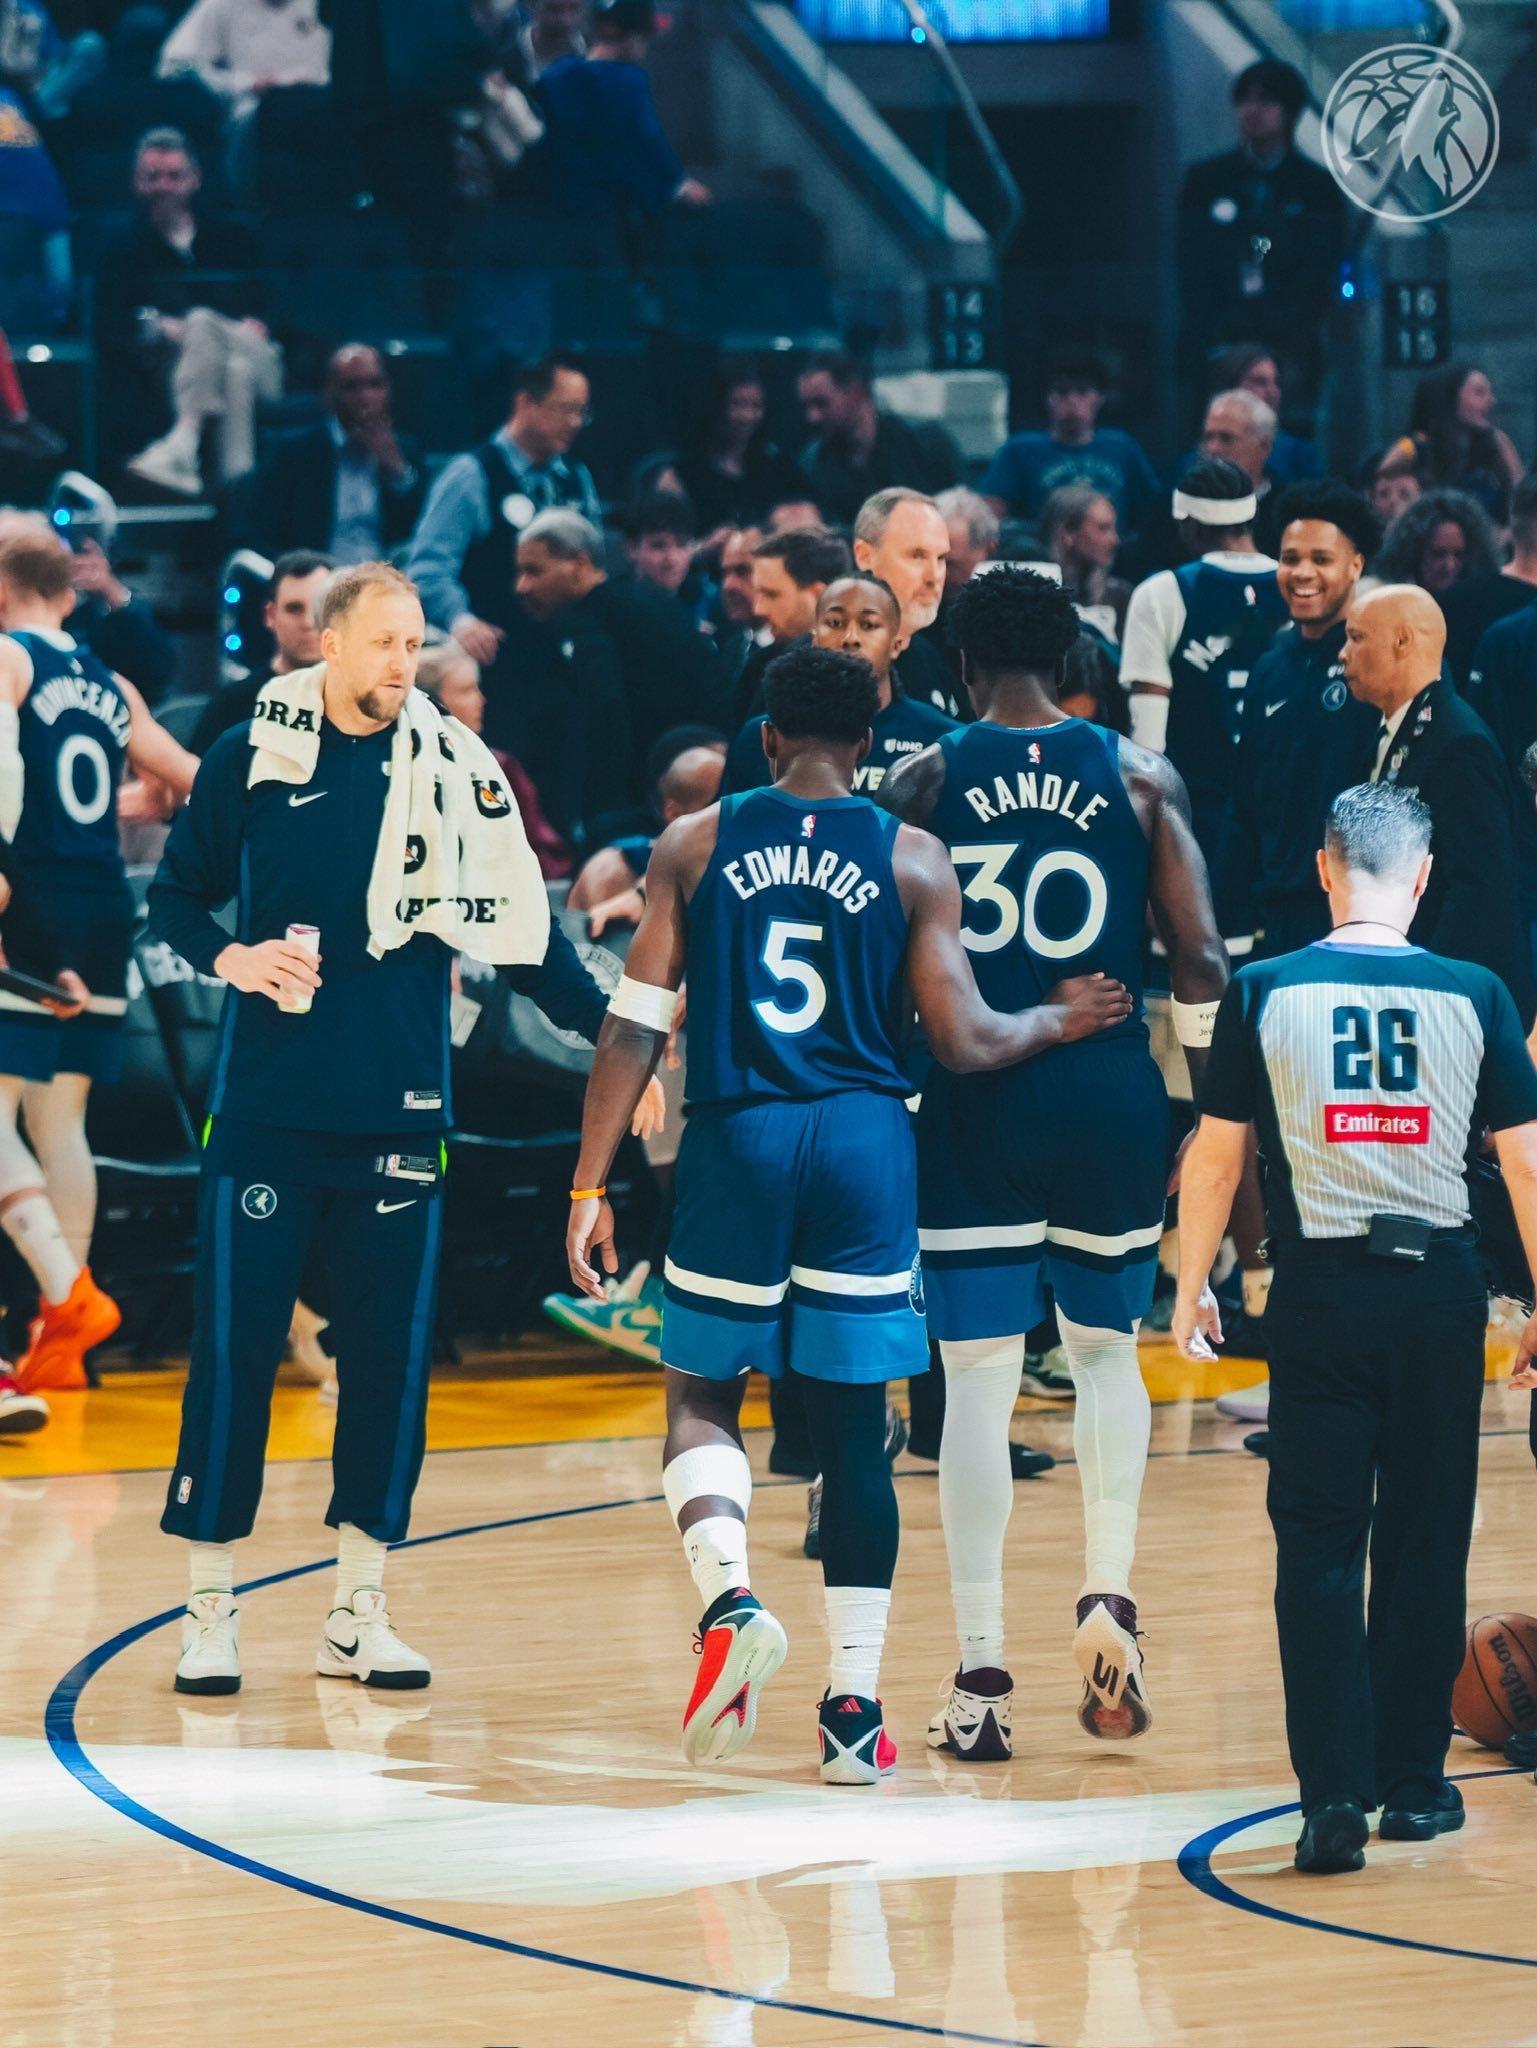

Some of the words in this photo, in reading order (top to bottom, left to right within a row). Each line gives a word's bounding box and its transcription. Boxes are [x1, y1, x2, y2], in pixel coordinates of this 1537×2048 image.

[944, 289, 982, 317] 14
[1399, 287, 1436, 318] 16
[57, 734, 111, 825] 0
[964, 772, 1109, 831] RANDLE
[722, 845, 880, 914] EDWARDS
[951, 844, 1108, 959] 30
[754, 920, 828, 1034] 5
[1332, 1005, 1417, 1092] 26
[1333, 1112, 1420, 1134] Emirates
[1487, 1632, 1535, 1722] Wilson
